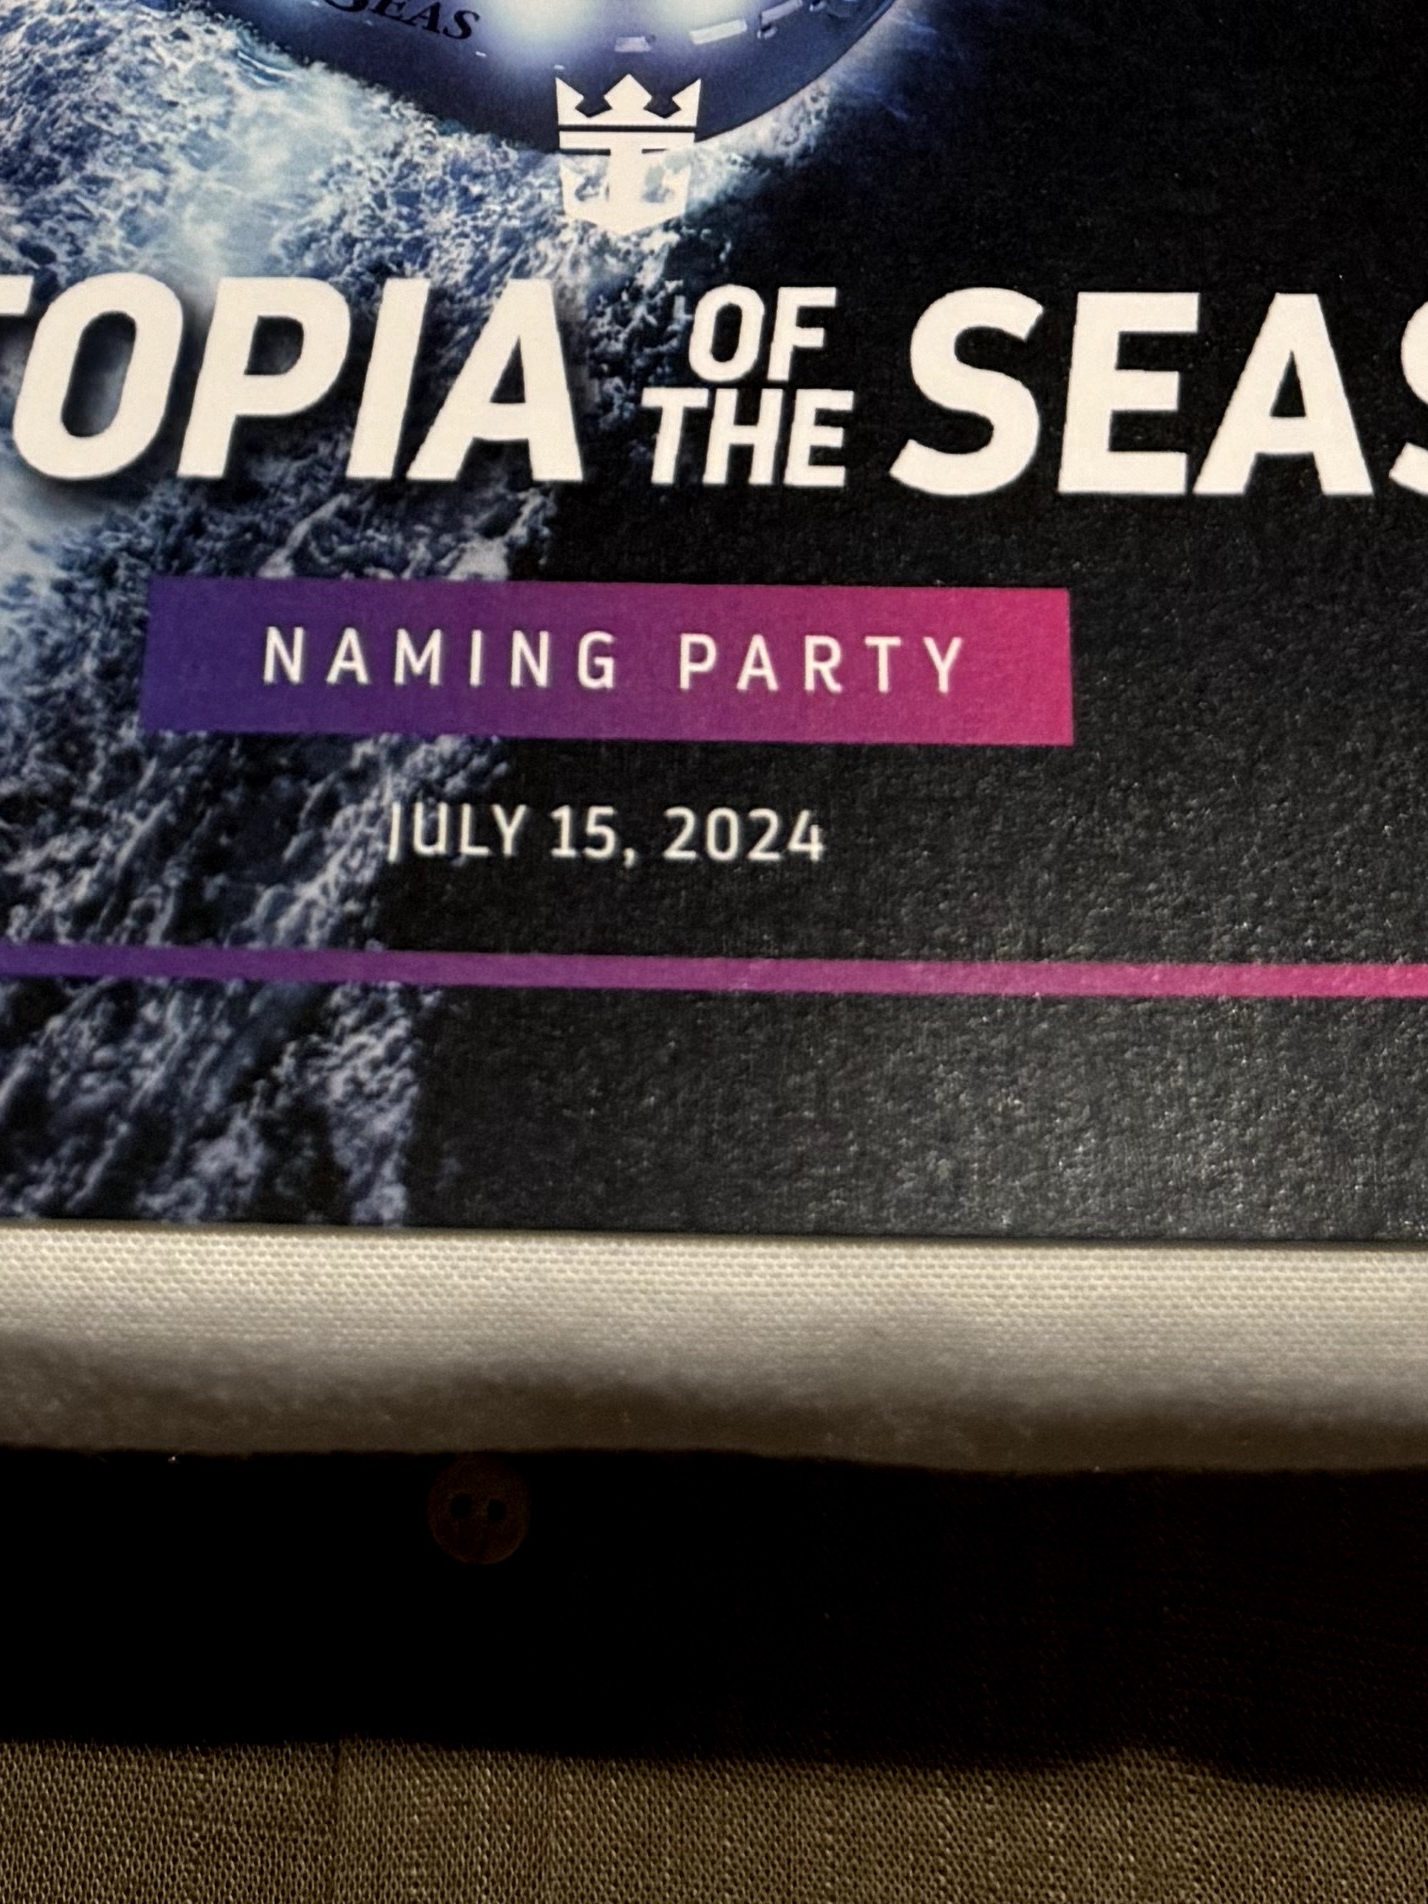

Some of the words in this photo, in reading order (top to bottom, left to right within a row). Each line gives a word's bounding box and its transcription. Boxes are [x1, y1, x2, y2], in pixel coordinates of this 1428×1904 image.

[689, 284, 837, 382] OF
[642, 387, 854, 487] THE
[263, 626, 616, 690] NAMING
[678, 632, 964, 695] PARTY
[386, 800, 527, 863] JULY
[550, 804, 637, 868] 15,
[663, 806, 825, 862] 2024
